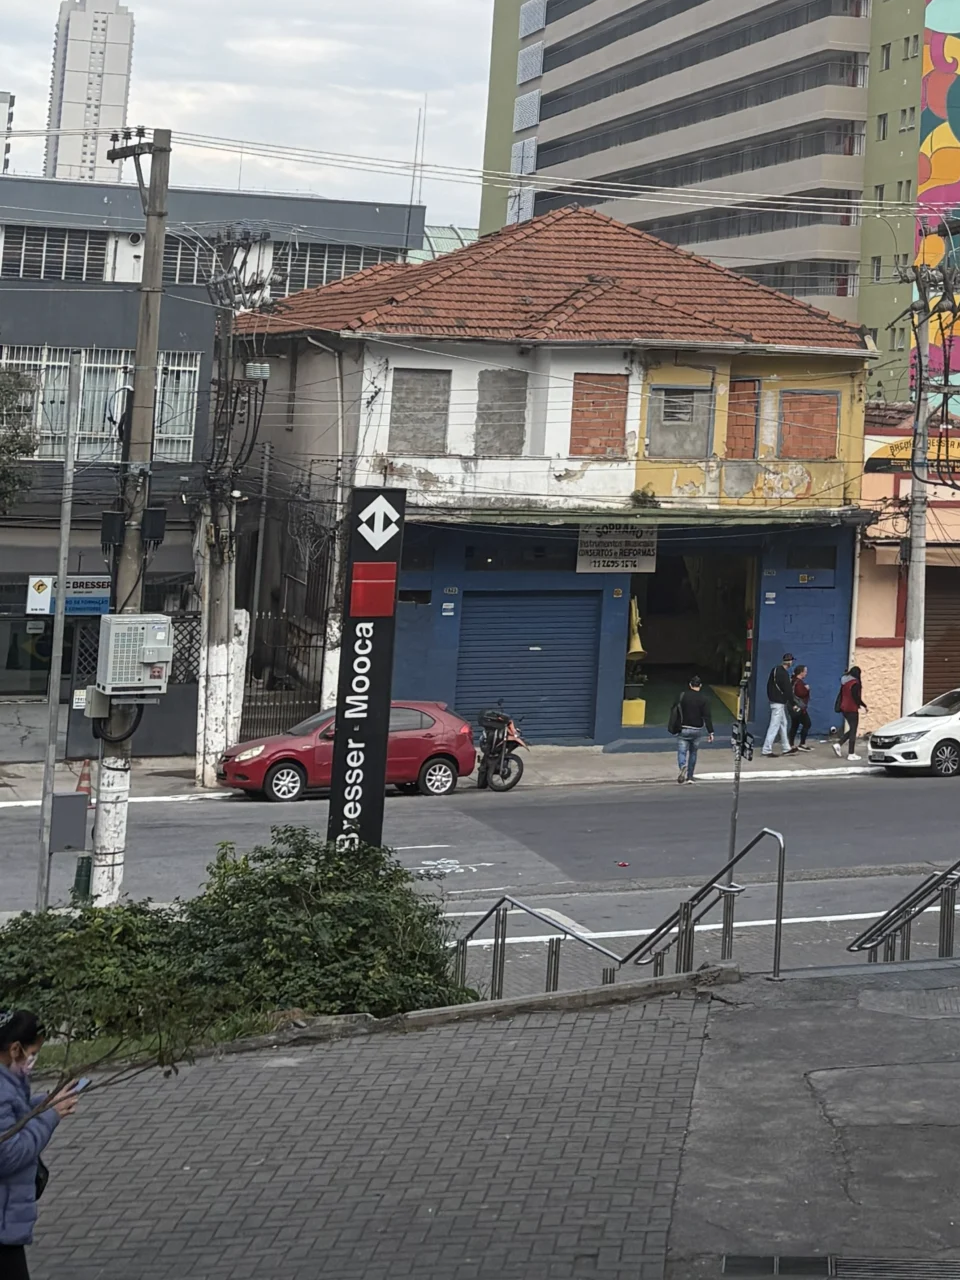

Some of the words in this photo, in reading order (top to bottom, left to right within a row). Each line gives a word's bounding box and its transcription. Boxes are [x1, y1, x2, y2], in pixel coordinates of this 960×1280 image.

[578, 548, 613, 557] CONSERTOS
[619, 548, 656, 557] REFORMAS
[72, 581, 112, 589] BRESSER
[344, 621, 375, 719] Mooca
[335, 737, 366, 854] Bresser
